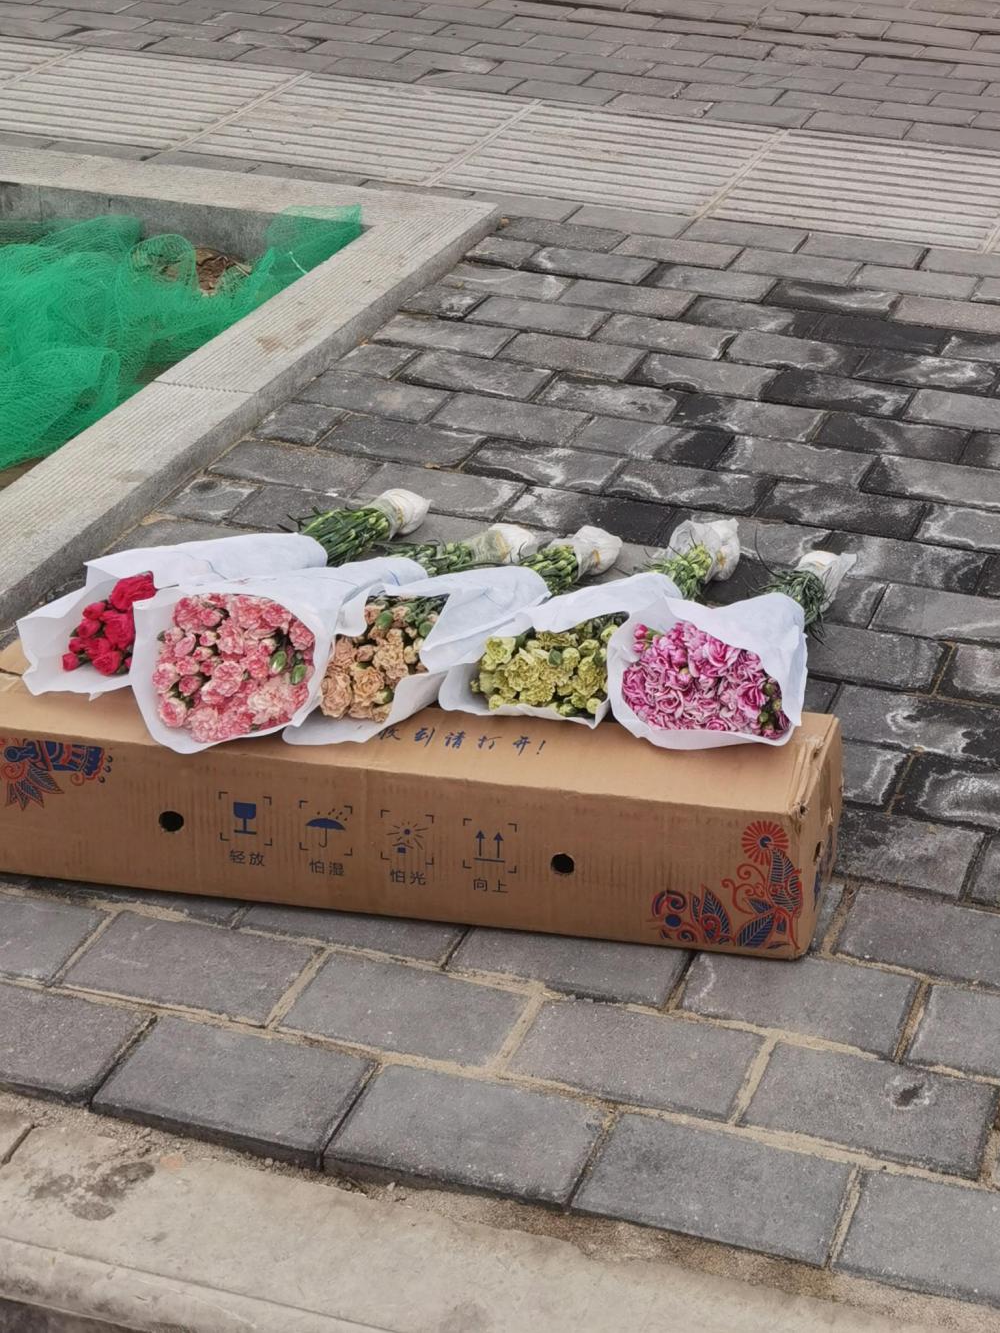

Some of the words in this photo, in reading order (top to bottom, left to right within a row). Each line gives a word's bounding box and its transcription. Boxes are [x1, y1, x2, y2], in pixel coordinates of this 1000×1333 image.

[229, 849, 265, 866] 轻放
[309, 858, 345, 876] 怕湿
[390, 869, 426, 886] 怕光
[473, 877, 509, 894] 向上
